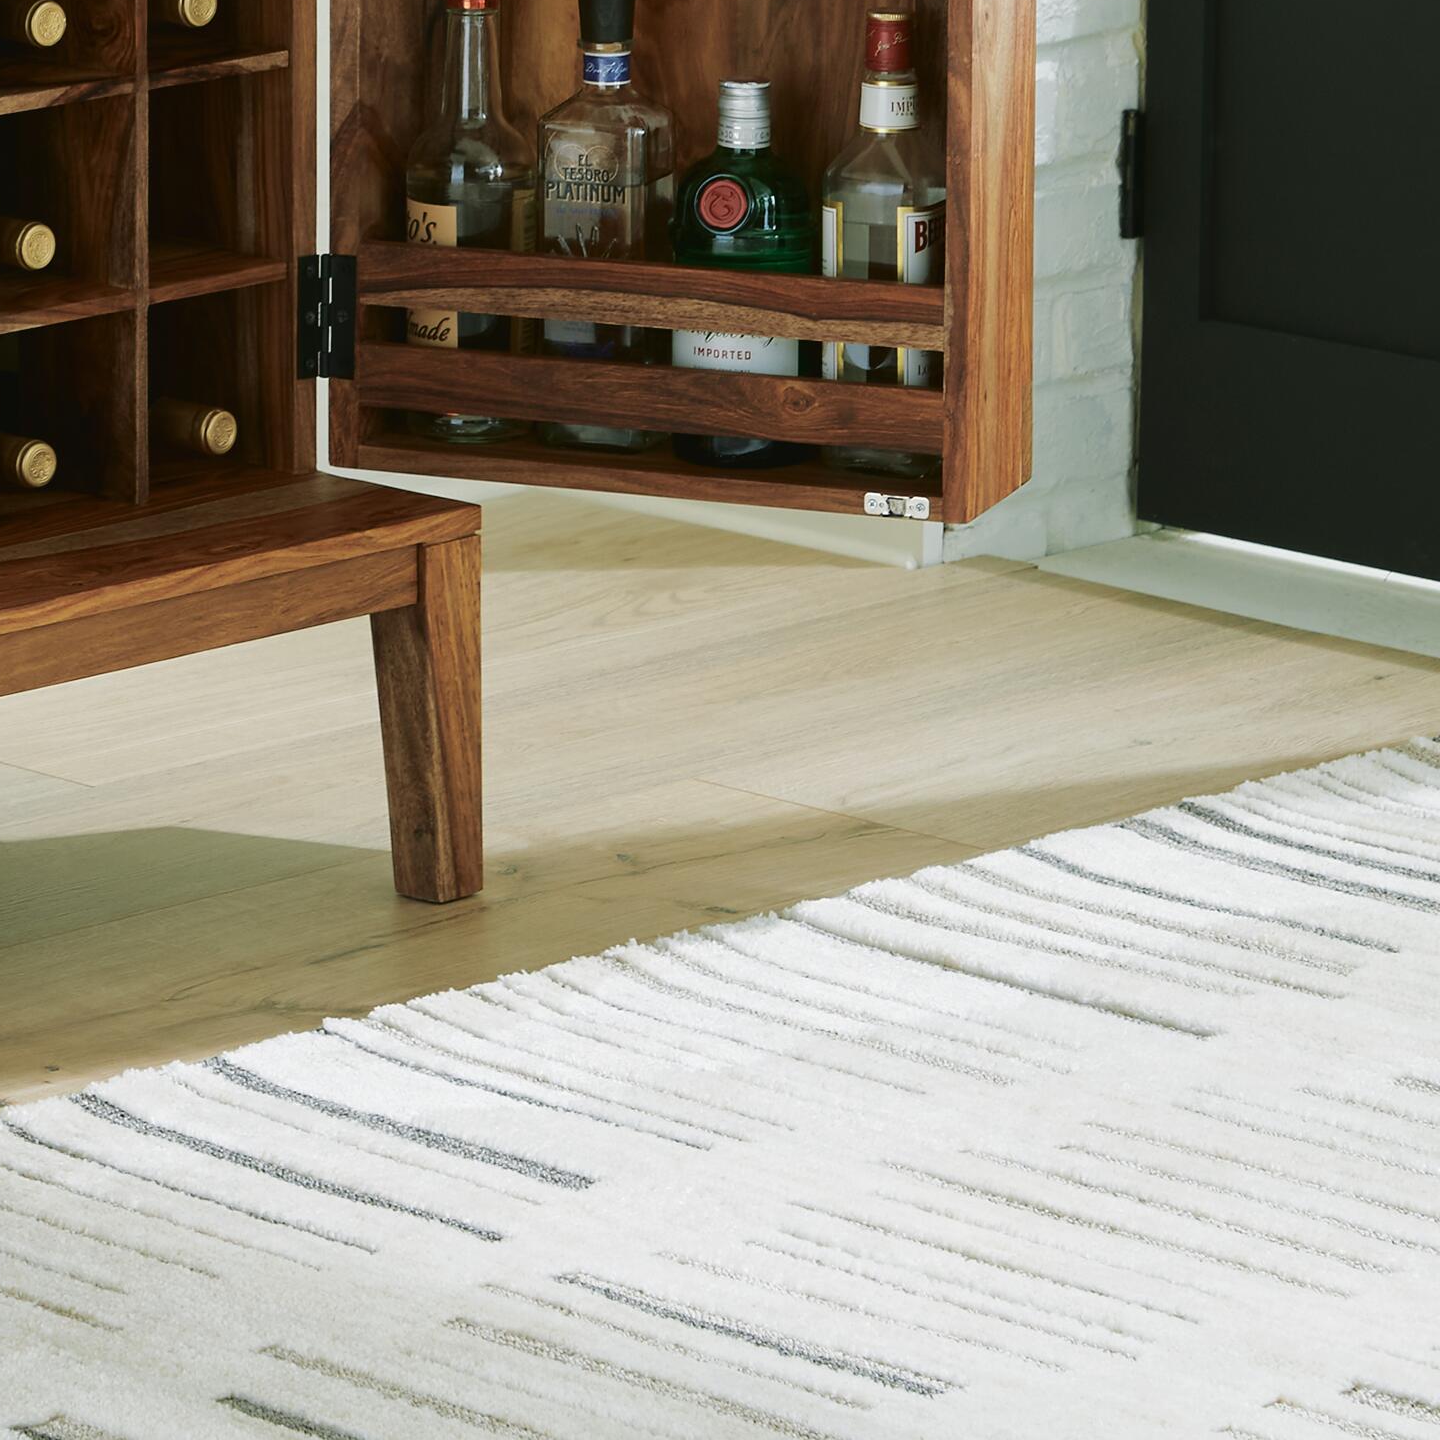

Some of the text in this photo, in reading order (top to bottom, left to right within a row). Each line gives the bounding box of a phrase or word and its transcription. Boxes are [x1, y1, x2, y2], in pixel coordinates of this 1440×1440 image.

[578, 154, 593, 167] EL
[562, 167, 610, 183] TESORO
[546, 181, 626, 204] PLATINUM
[693, 346, 752, 361] IMPORTED
